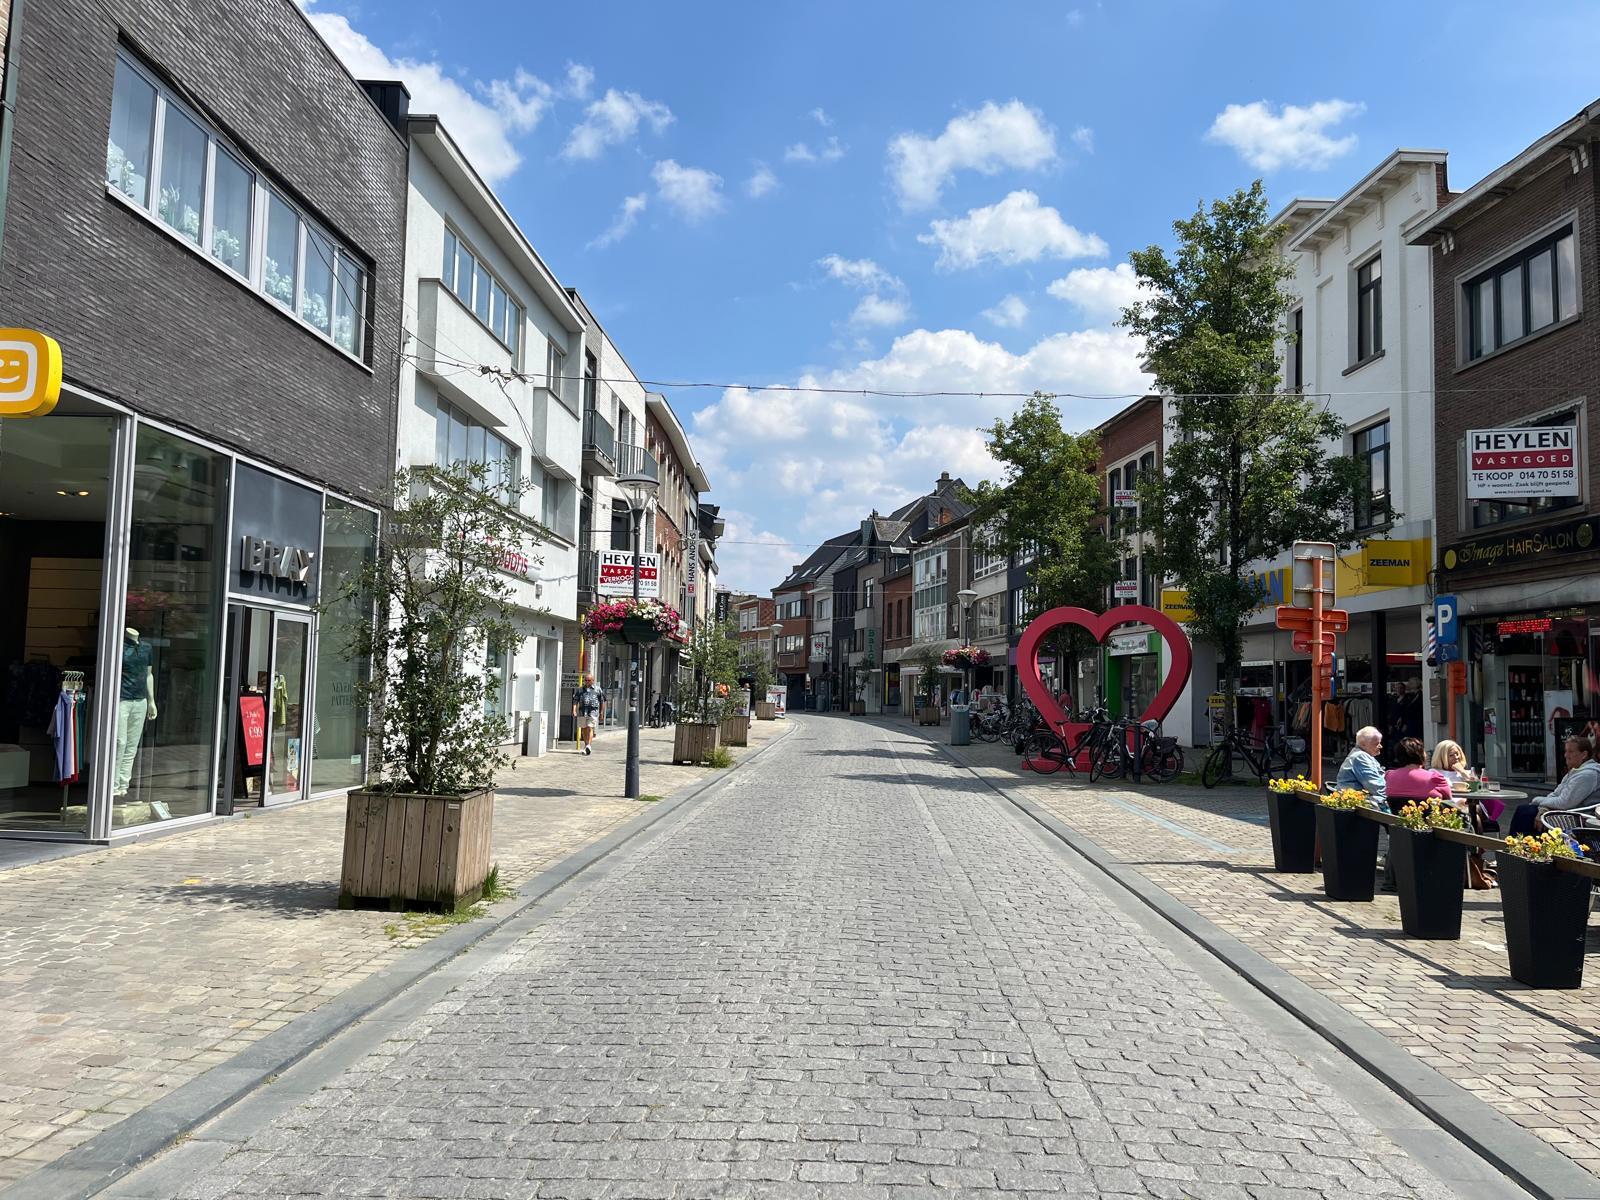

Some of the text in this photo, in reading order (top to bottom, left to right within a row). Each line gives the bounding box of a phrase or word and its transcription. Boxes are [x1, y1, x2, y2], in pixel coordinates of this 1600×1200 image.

[1475, 431, 1569, 450] HEYLEN
[1475, 455, 1570, 465] VASTGOED
[1472, 469, 1574, 481] TE KOOP 014 70 51 58
[1369, 559, 1410, 567] ZEEMAN
[603, 567, 656, 577] VASTGED
[688, 562, 696, 582] HANS
[1437, 604, 1453, 638] P
